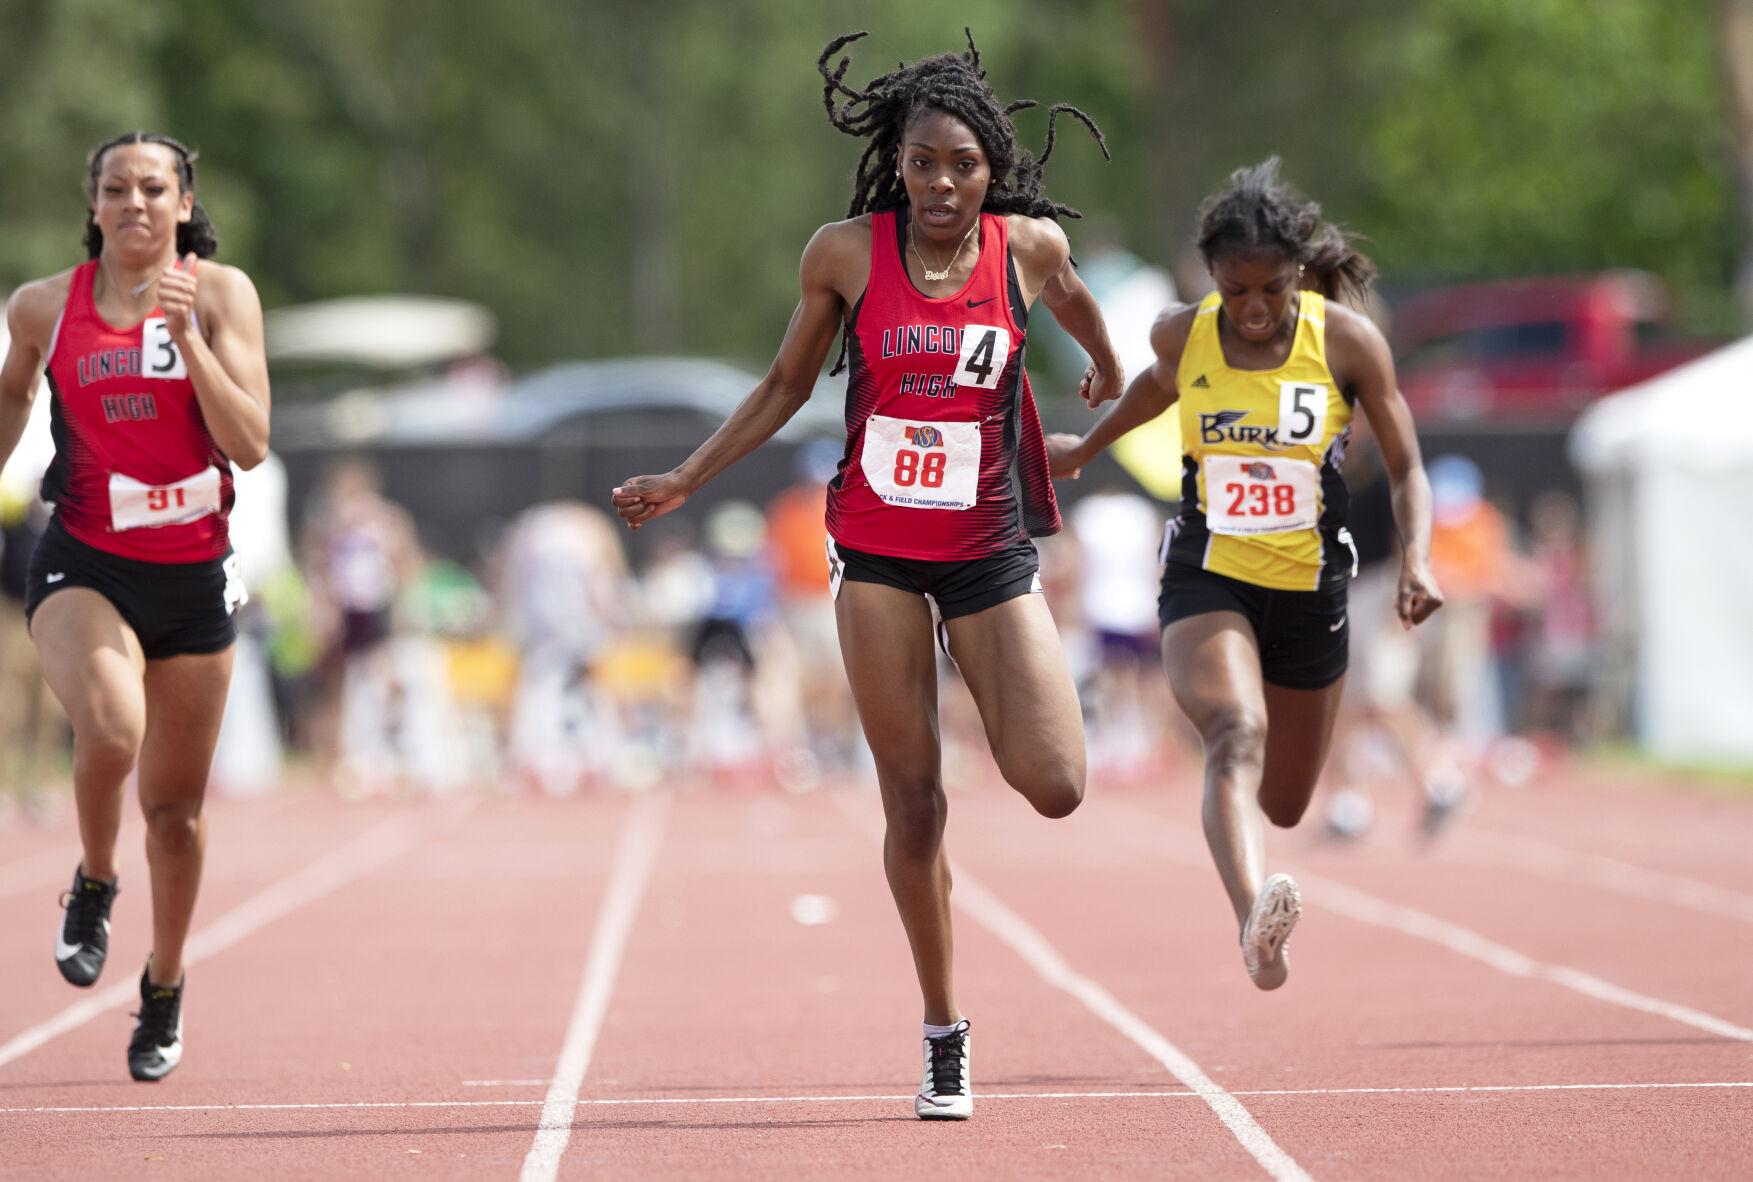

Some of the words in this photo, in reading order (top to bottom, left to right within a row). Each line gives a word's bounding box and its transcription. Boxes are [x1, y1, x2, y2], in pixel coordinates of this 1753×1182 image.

[152, 323, 177, 372] 3
[880, 324, 965, 359] LINCO
[964, 329, 997, 385] 4
[77, 348, 143, 388] LINCO
[900, 372, 959, 399] HIGH
[102, 392, 158, 423] HIGH
[1290, 387, 1316, 439] 5
[893, 449, 947, 488] 88
[147, 488, 185, 512] 91
[914, 499, 964, 508] CHAMPIONSHIPS
[1226, 483, 1296, 516] 238
